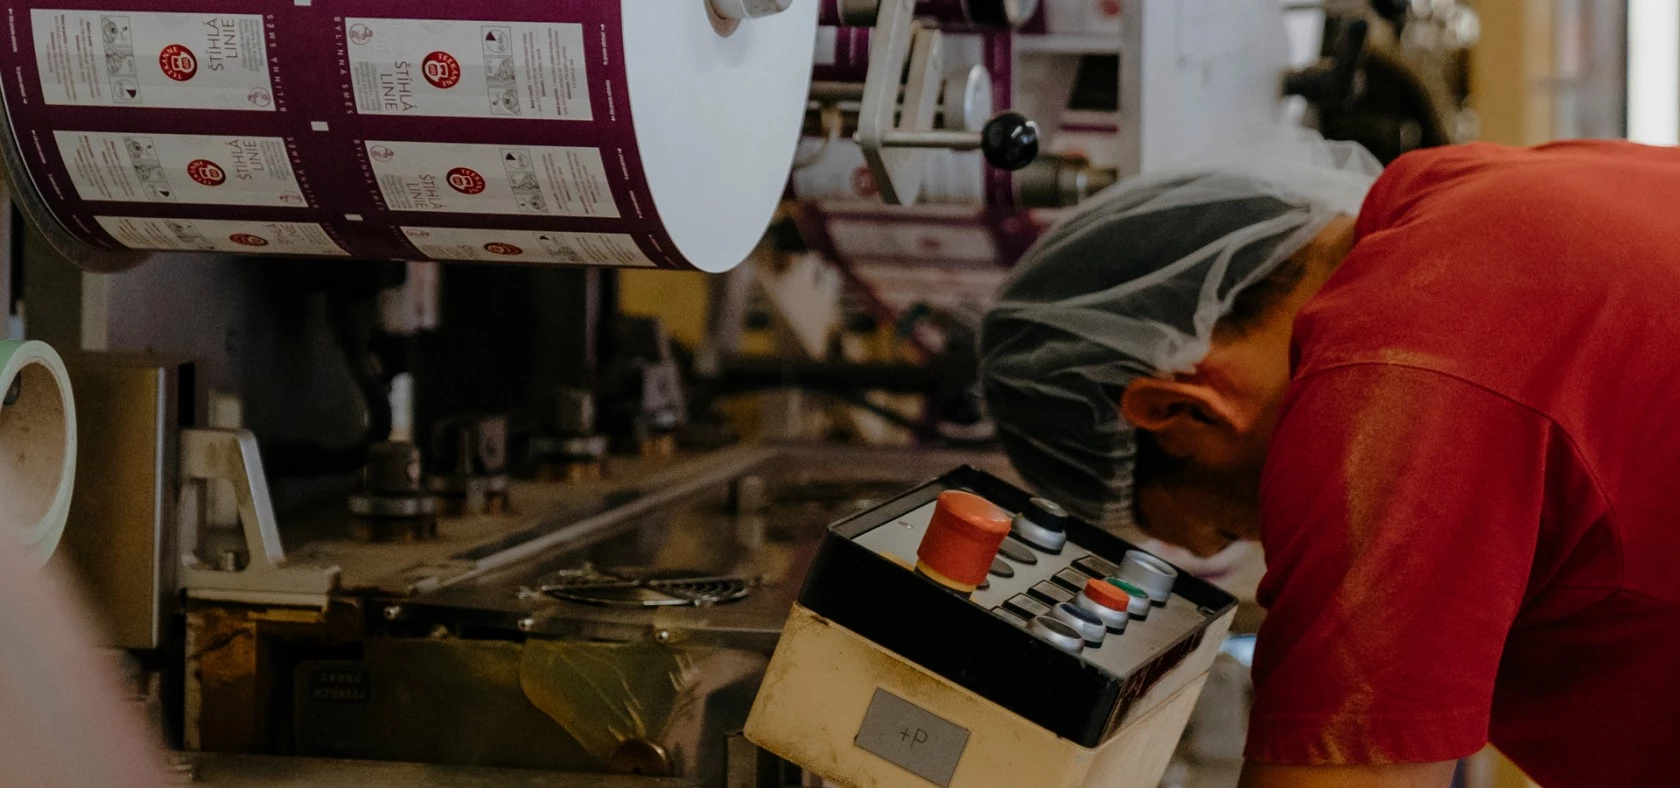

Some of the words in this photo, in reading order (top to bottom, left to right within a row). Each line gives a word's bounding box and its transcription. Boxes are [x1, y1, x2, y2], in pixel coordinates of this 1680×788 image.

[203, 17, 224, 71] ŠTÍHLÁ
[222, 18, 238, 58] LINIE
[380, 74, 398, 111] LINIE
[394, 60, 417, 112] ŠTÍHLÁ
[244, 139, 265, 172] LINIE
[406, 182, 428, 209] LINIE
